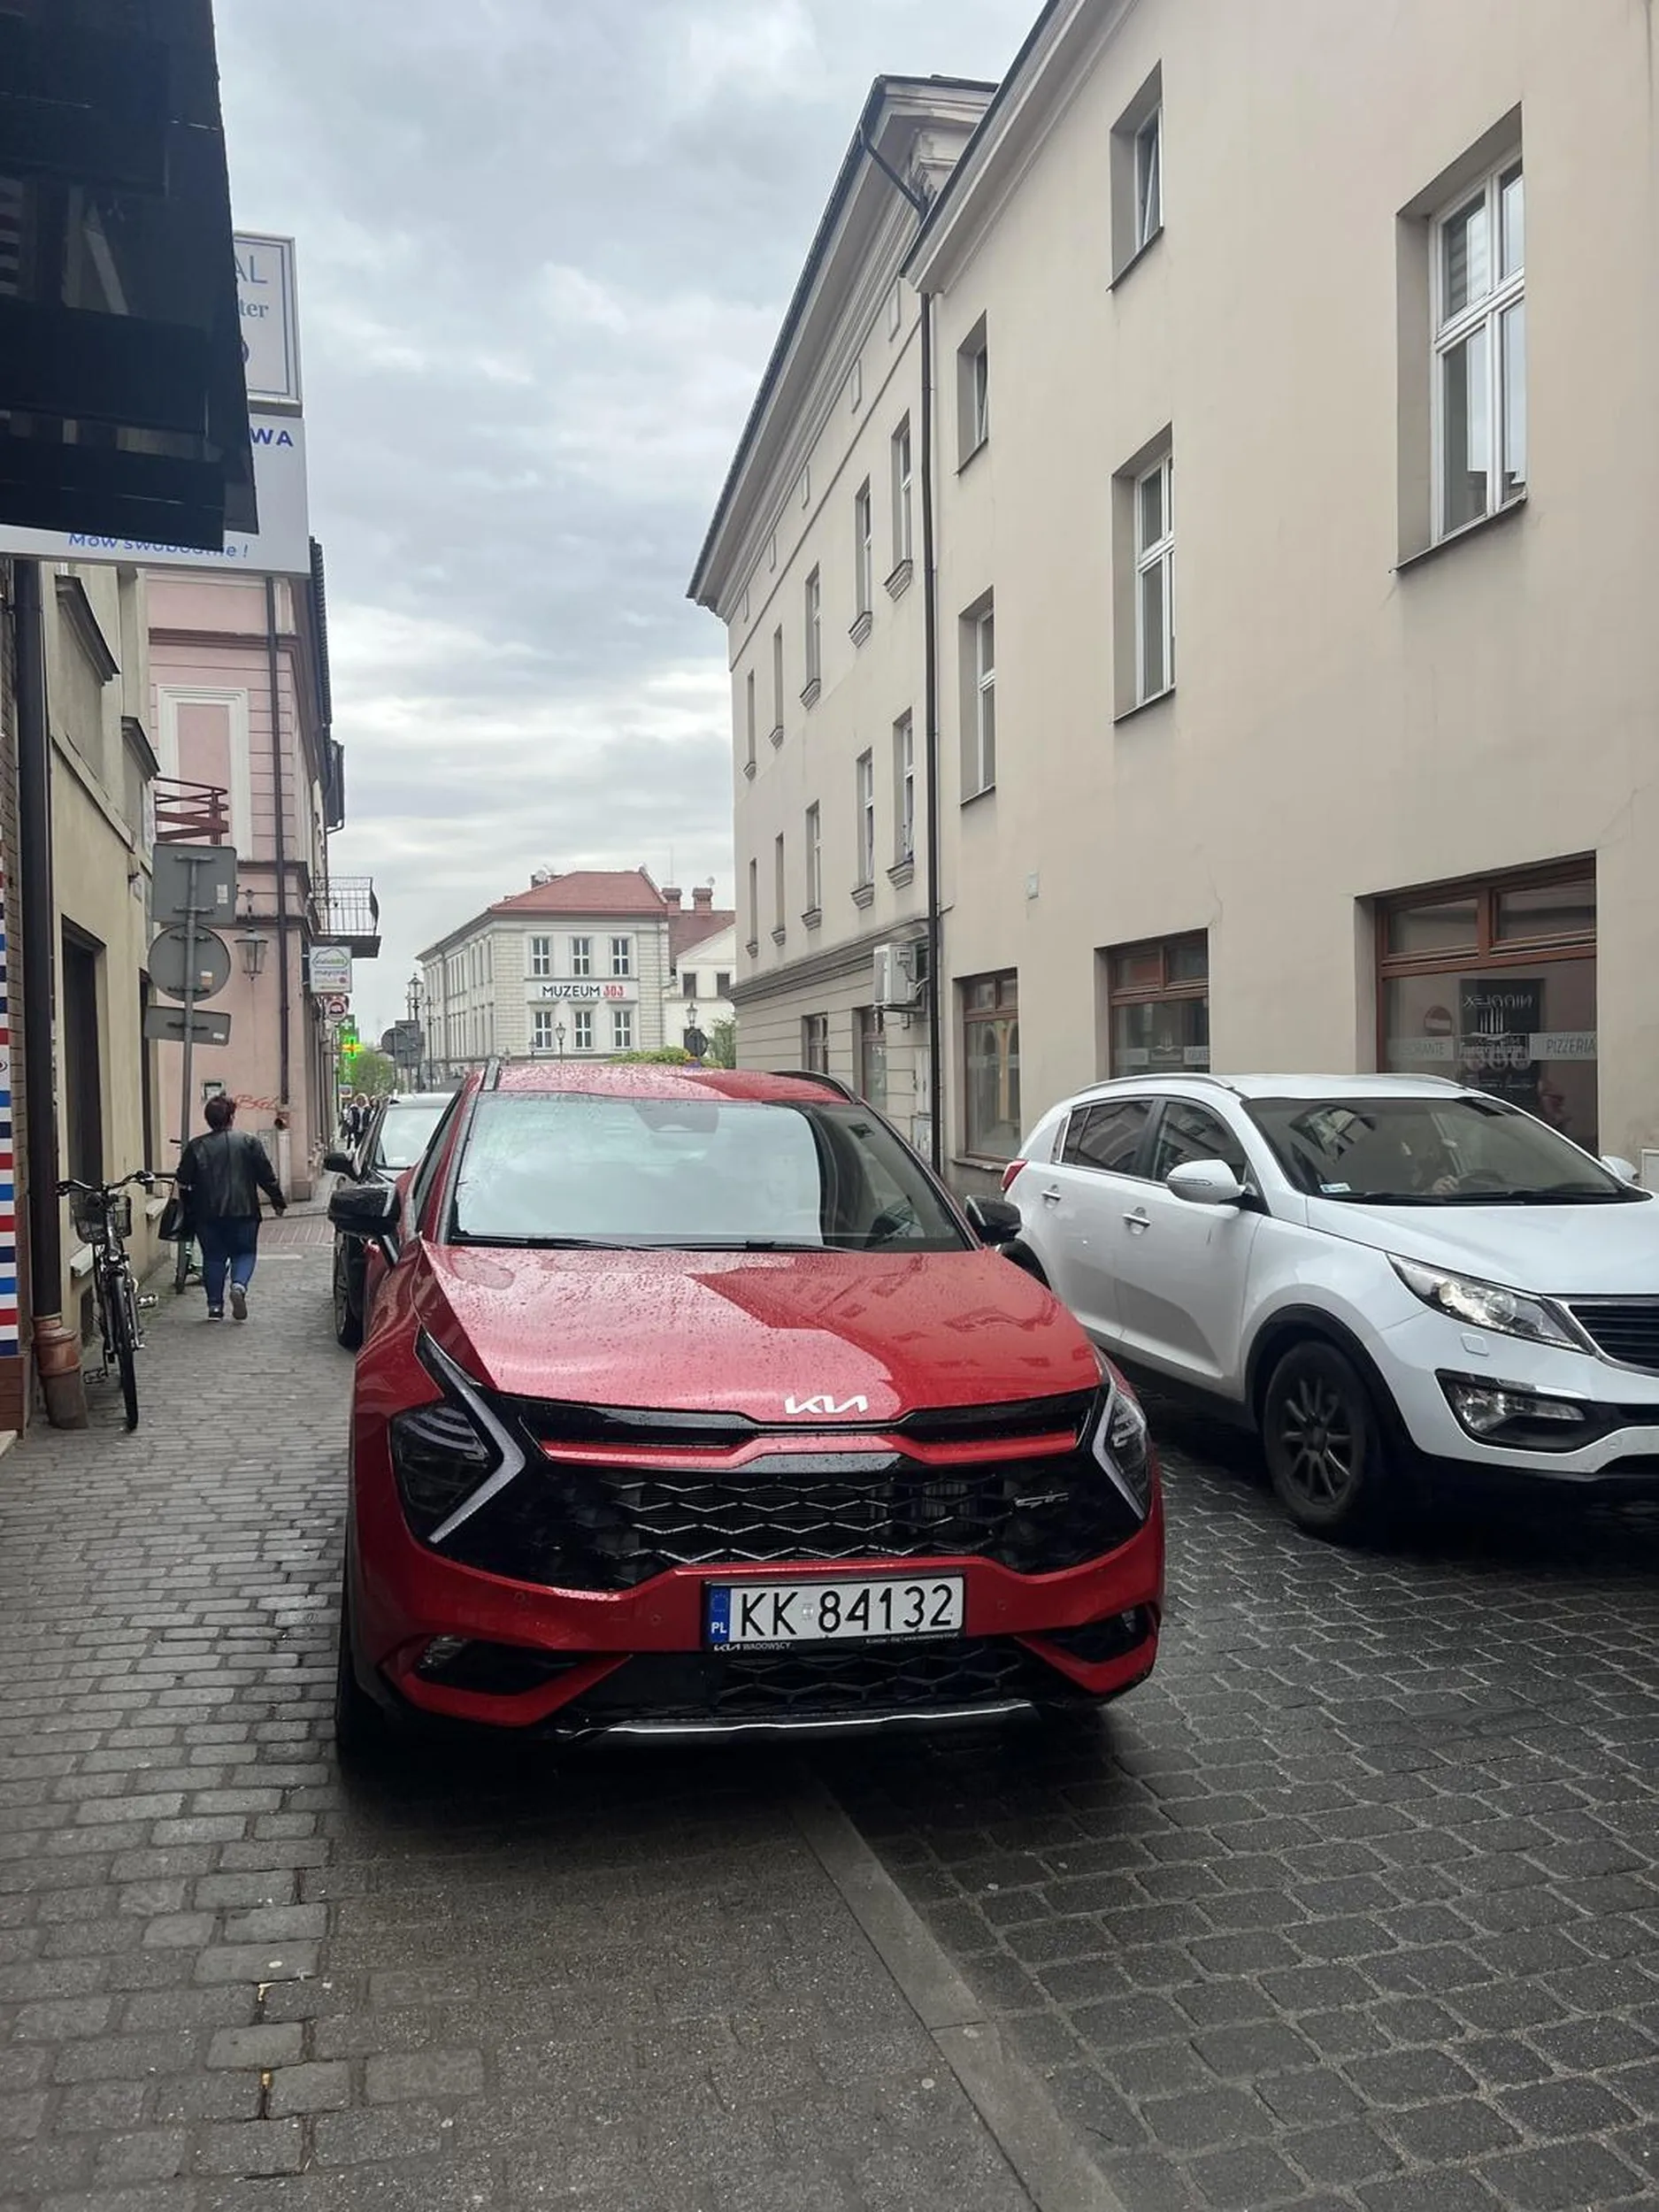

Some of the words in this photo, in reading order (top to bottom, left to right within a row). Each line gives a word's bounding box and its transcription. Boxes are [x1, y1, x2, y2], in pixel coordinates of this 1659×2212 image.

[250, 427, 294, 447] WA
[542, 985, 600, 997] MUZEUM
[785, 1394, 869, 1415] KIA
[741, 1592, 798, 1637] KK
[818, 1584, 954, 1633] 84132
[710, 1622, 727, 1634] PL
